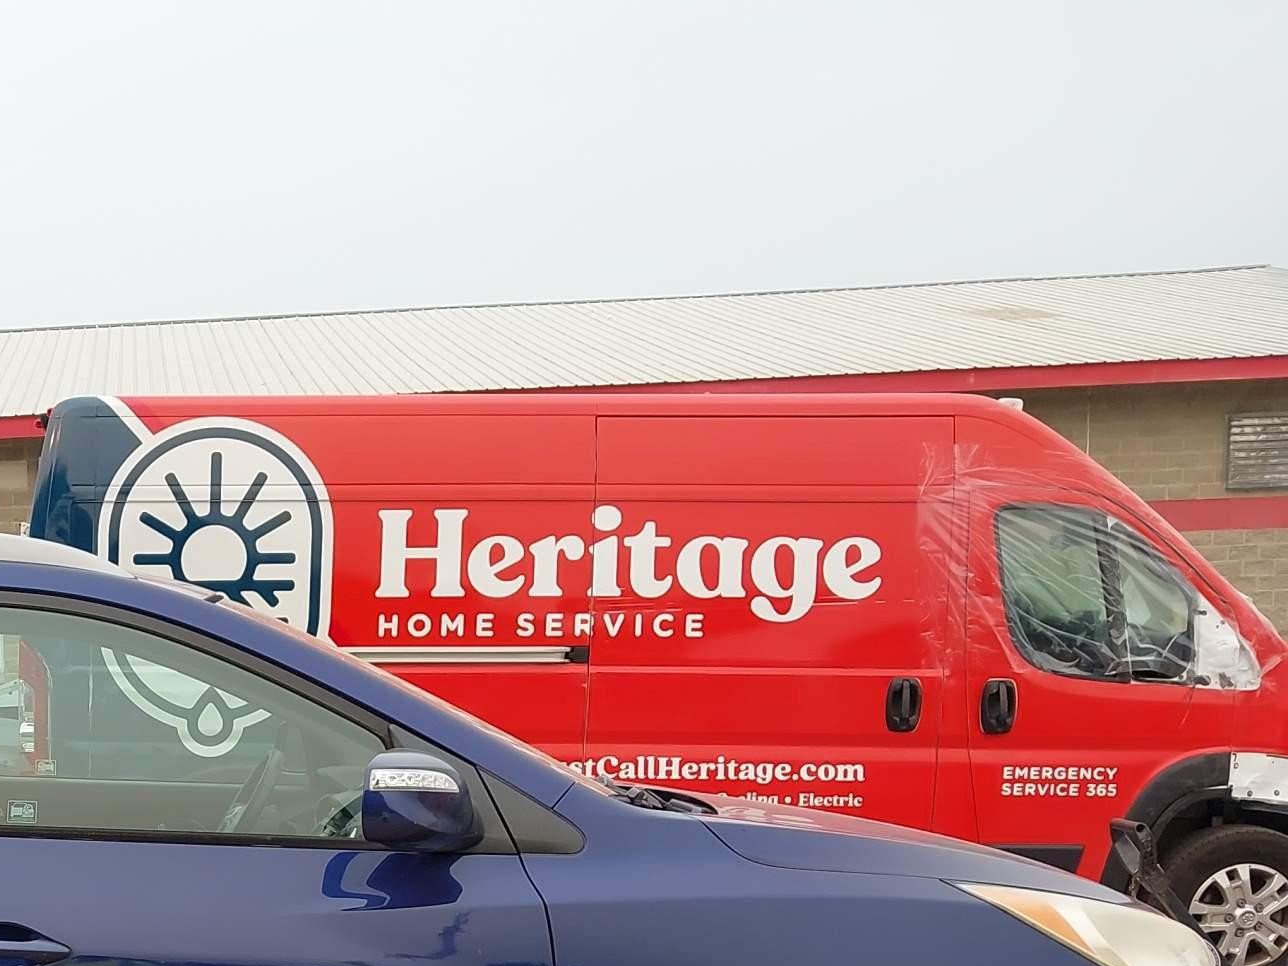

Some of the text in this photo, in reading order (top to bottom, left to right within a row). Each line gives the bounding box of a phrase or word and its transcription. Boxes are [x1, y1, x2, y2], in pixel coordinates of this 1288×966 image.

[374, 504, 883, 623] Heritage
[377, 612, 705, 639] HOME SERVICE
[560, 755, 865, 782] stCallHeritage.com
[1003, 766, 1117, 780] EMERGENCY
[798, 792, 864, 808] Electric
[1001, 783, 1117, 797] SERVICE 365
